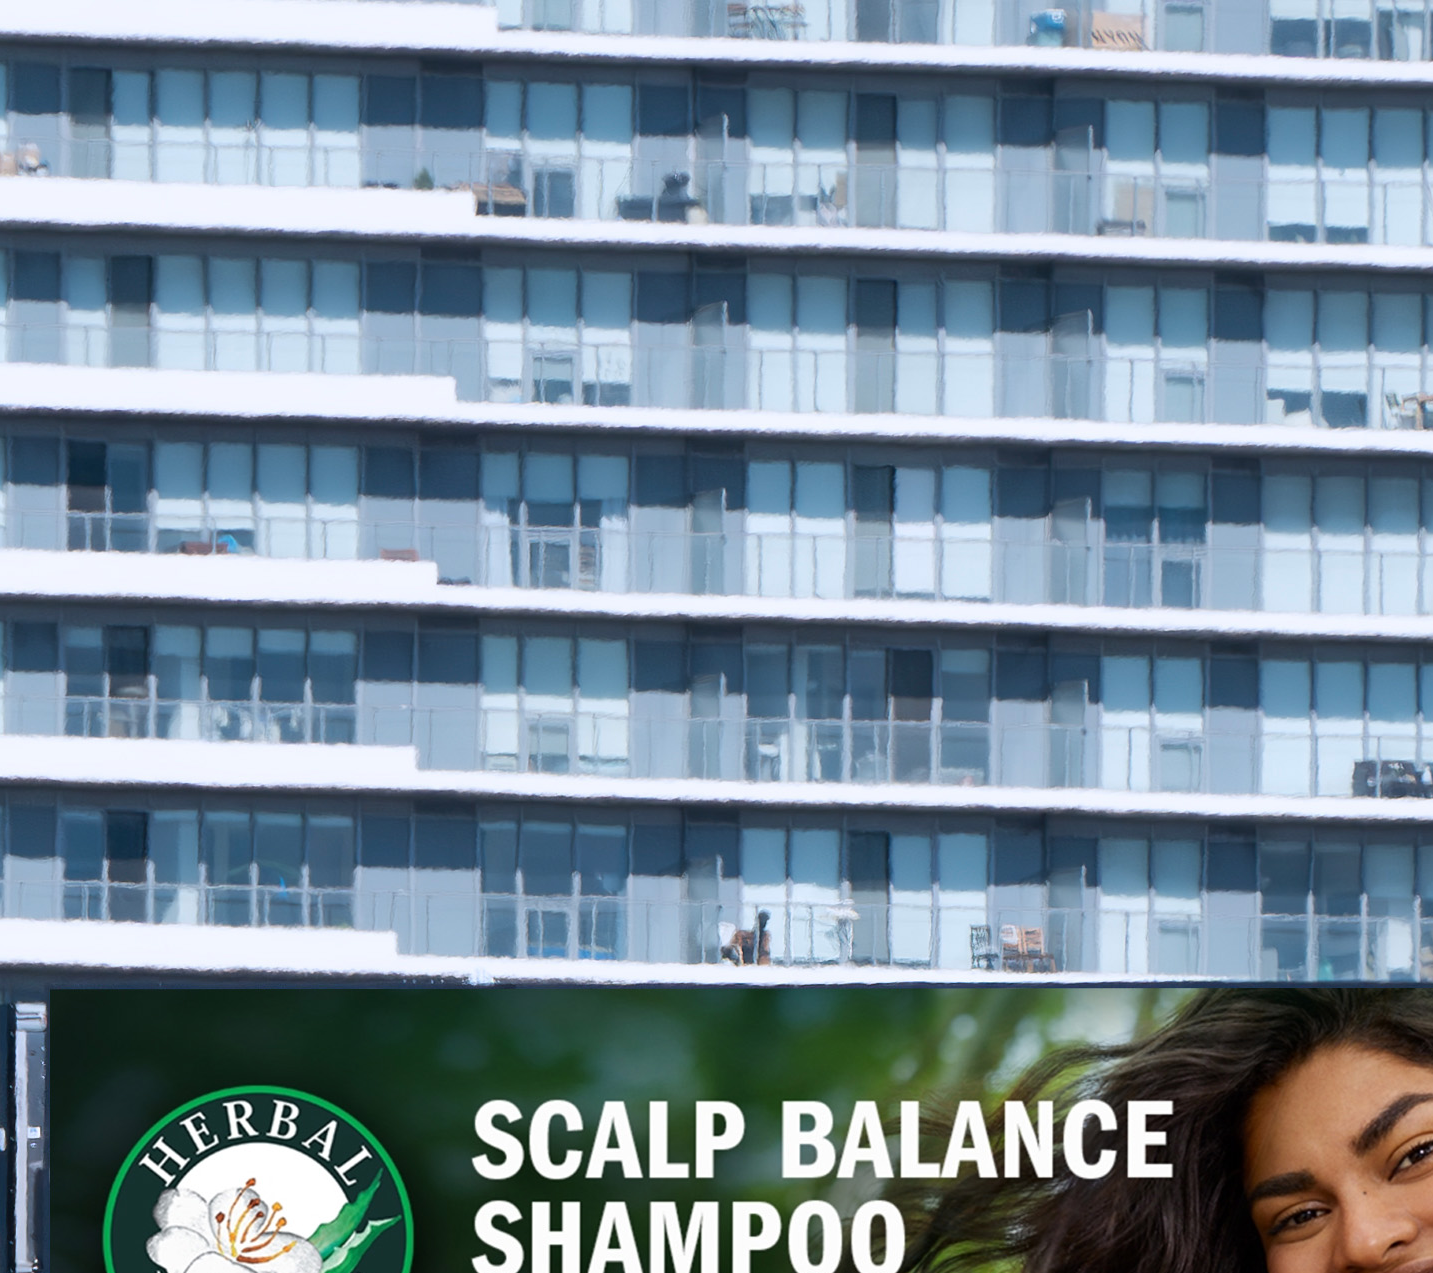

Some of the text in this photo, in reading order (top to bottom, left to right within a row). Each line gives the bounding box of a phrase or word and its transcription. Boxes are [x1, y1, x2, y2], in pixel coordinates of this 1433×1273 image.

[139, 1098, 377, 1188] HERBAL
[472, 1099, 1173, 1180] SCALP BALANCE
